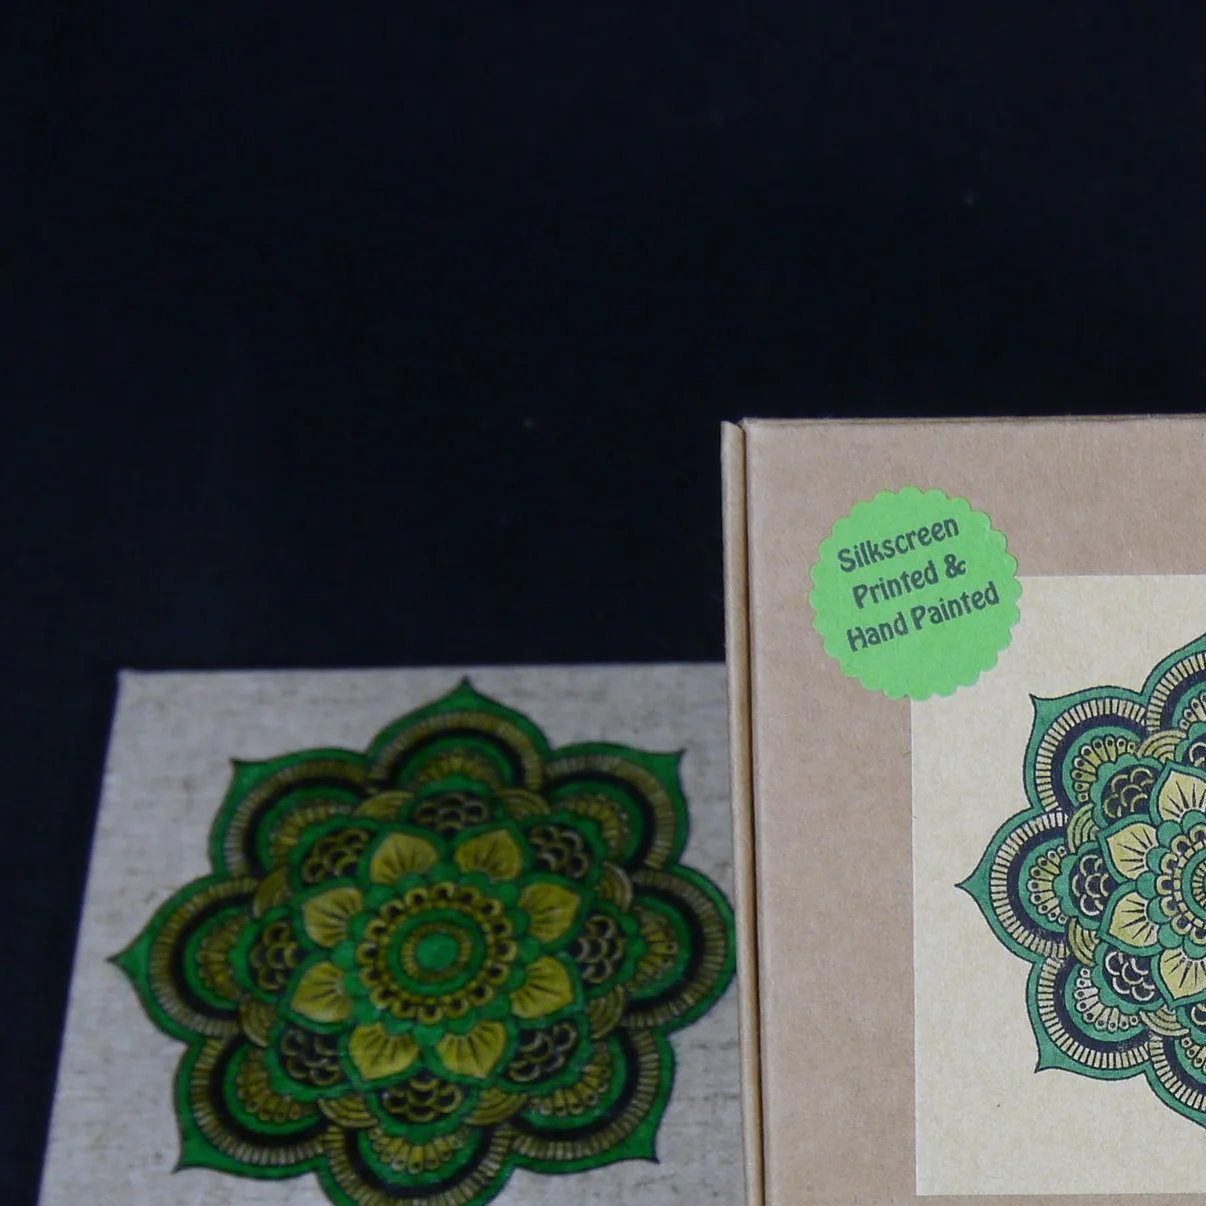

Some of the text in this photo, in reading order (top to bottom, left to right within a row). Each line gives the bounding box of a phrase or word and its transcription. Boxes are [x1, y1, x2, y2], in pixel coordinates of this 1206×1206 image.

[837, 518, 960, 573] Silkscreen
[852, 553, 966, 609] Printed &
[846, 581, 1000, 652] Hand Painted
